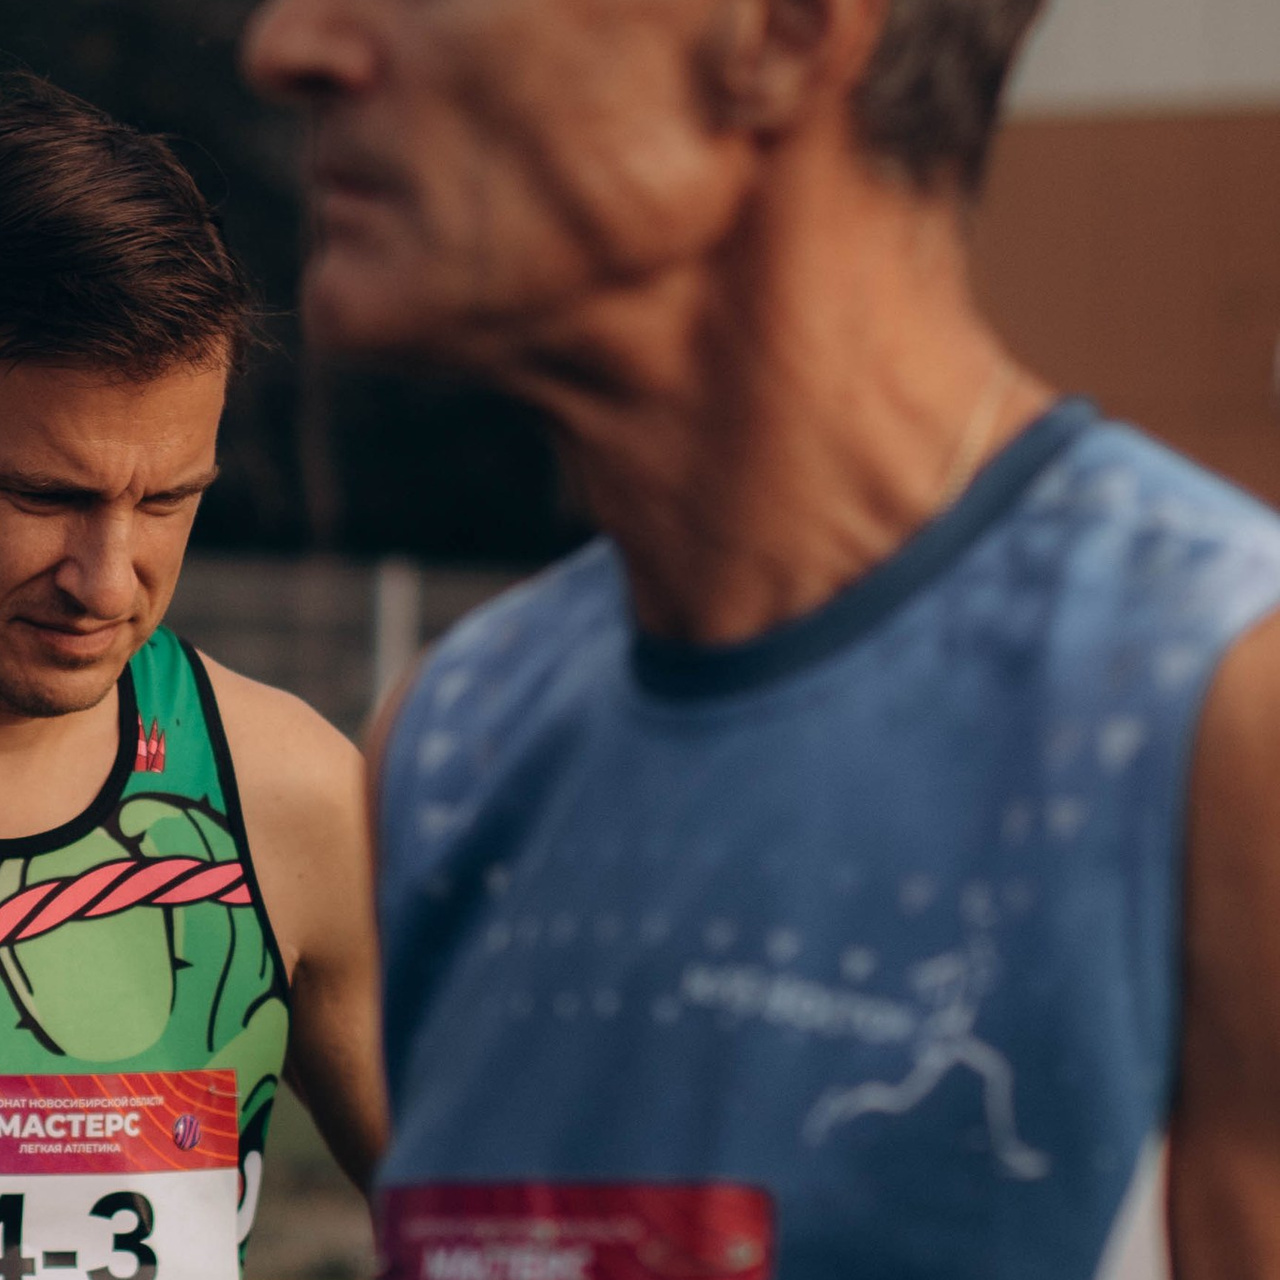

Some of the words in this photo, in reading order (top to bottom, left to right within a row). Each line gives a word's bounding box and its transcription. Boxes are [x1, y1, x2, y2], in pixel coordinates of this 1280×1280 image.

[29, 1097, 128, 1109] НОВОСИБИРСКОЙ
[19, 1144, 62, 1154] ЛЕГКАЯ
[64, 1143, 120, 1153] АТЛЕТИКА
